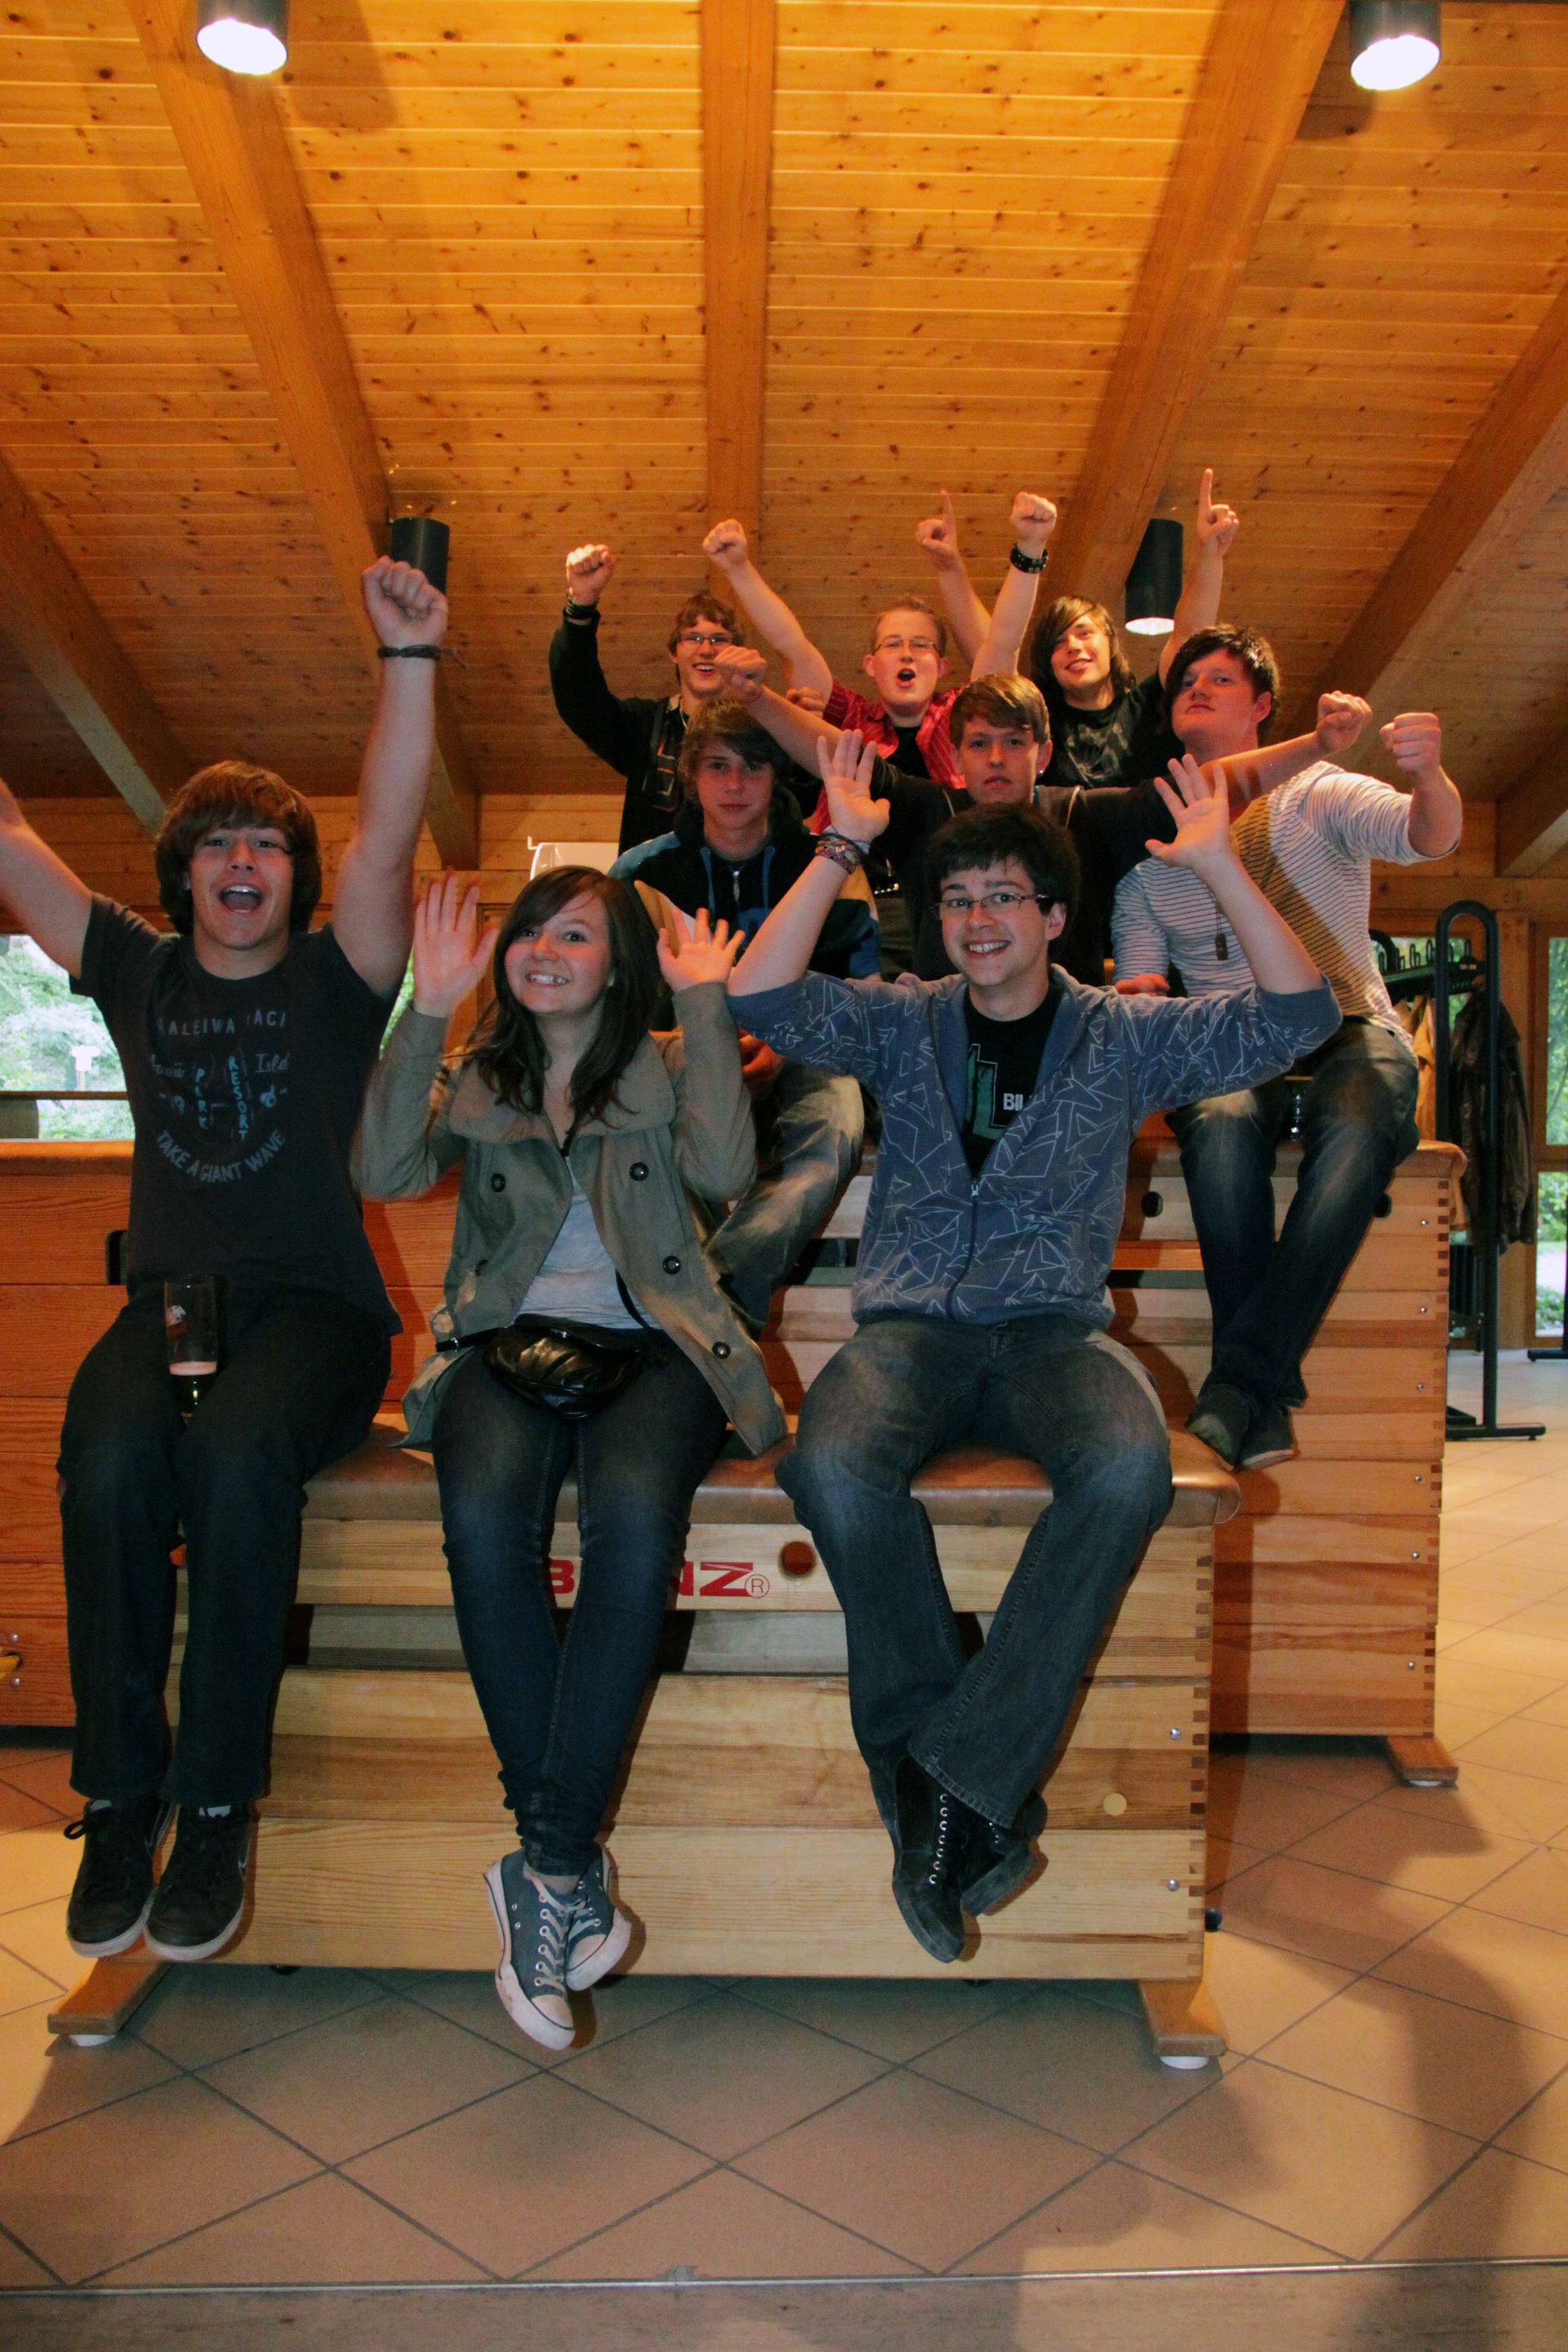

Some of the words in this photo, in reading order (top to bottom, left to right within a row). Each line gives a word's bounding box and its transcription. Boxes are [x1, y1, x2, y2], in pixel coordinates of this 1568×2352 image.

[229, 1056, 249, 1143] RESORT
[157, 1130, 191, 1169] TAKE
[186, 1160, 200, 1177] A
[200, 1162, 242, 1183] GIANT
[245, 1129, 286, 1172] WAVE
